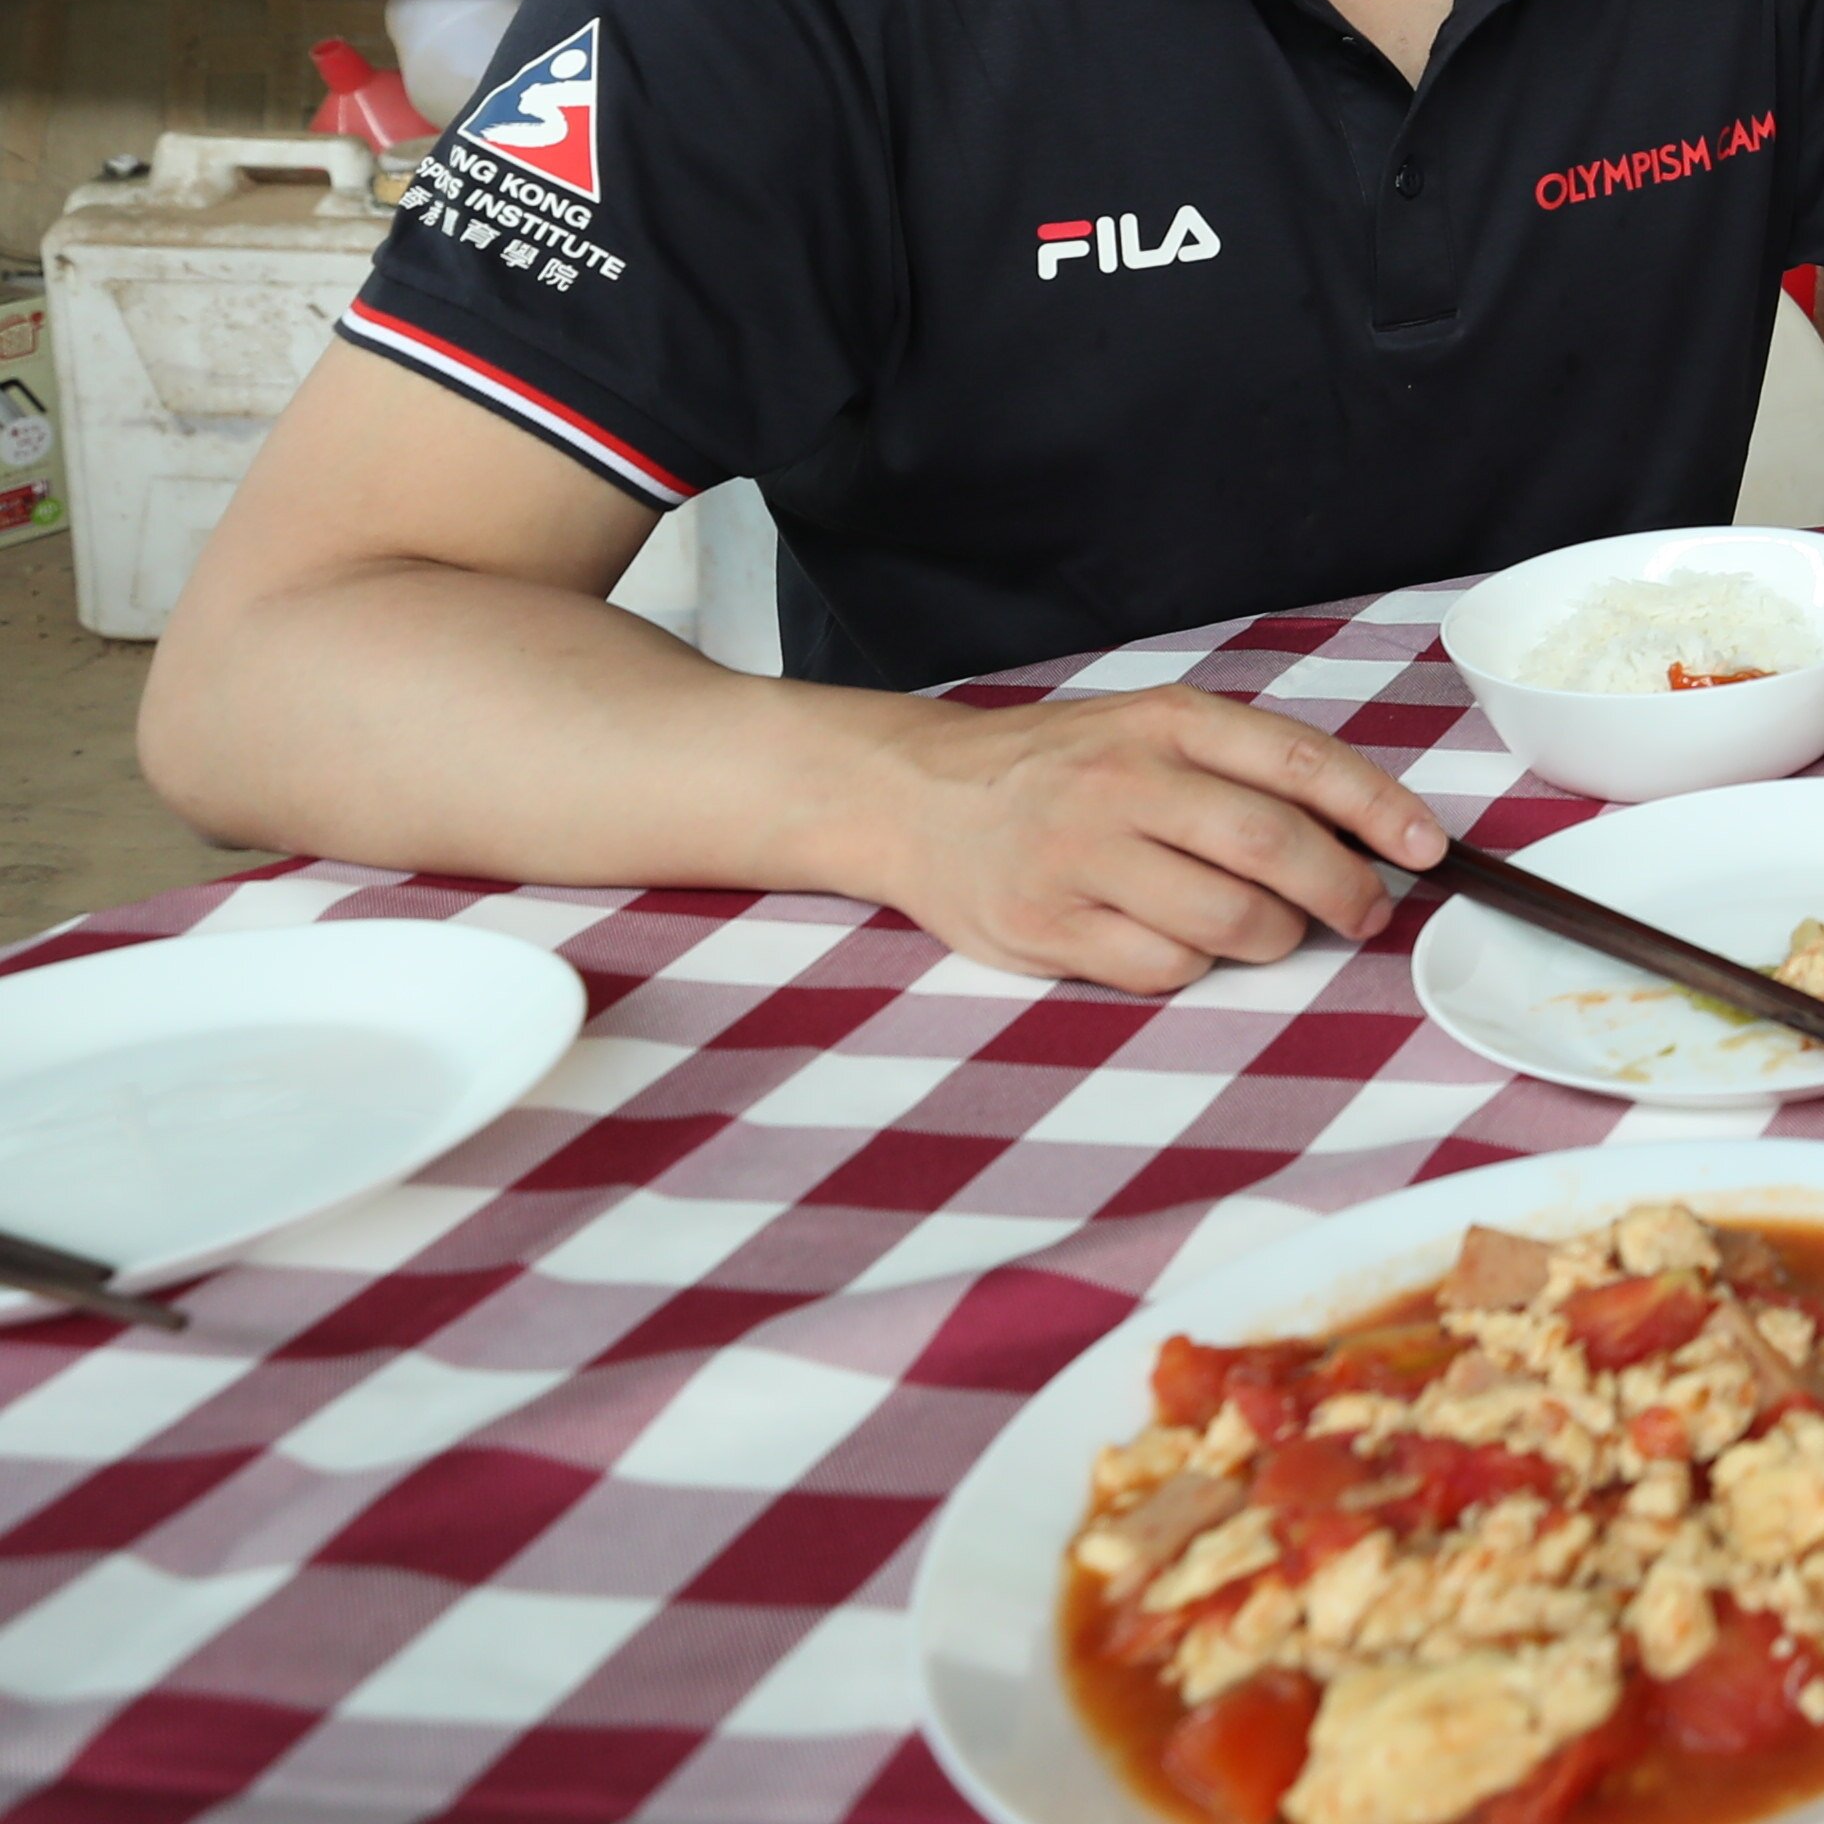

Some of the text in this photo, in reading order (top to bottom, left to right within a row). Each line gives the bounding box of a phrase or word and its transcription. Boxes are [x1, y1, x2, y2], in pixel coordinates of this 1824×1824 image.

[499, 172, 593, 230] KONG
[1535, 110, 1777, 210] OLYMPISM CAM
[464, 189, 627, 281] INSTITUTE
[1037, 204, 1222, 281] FILA
